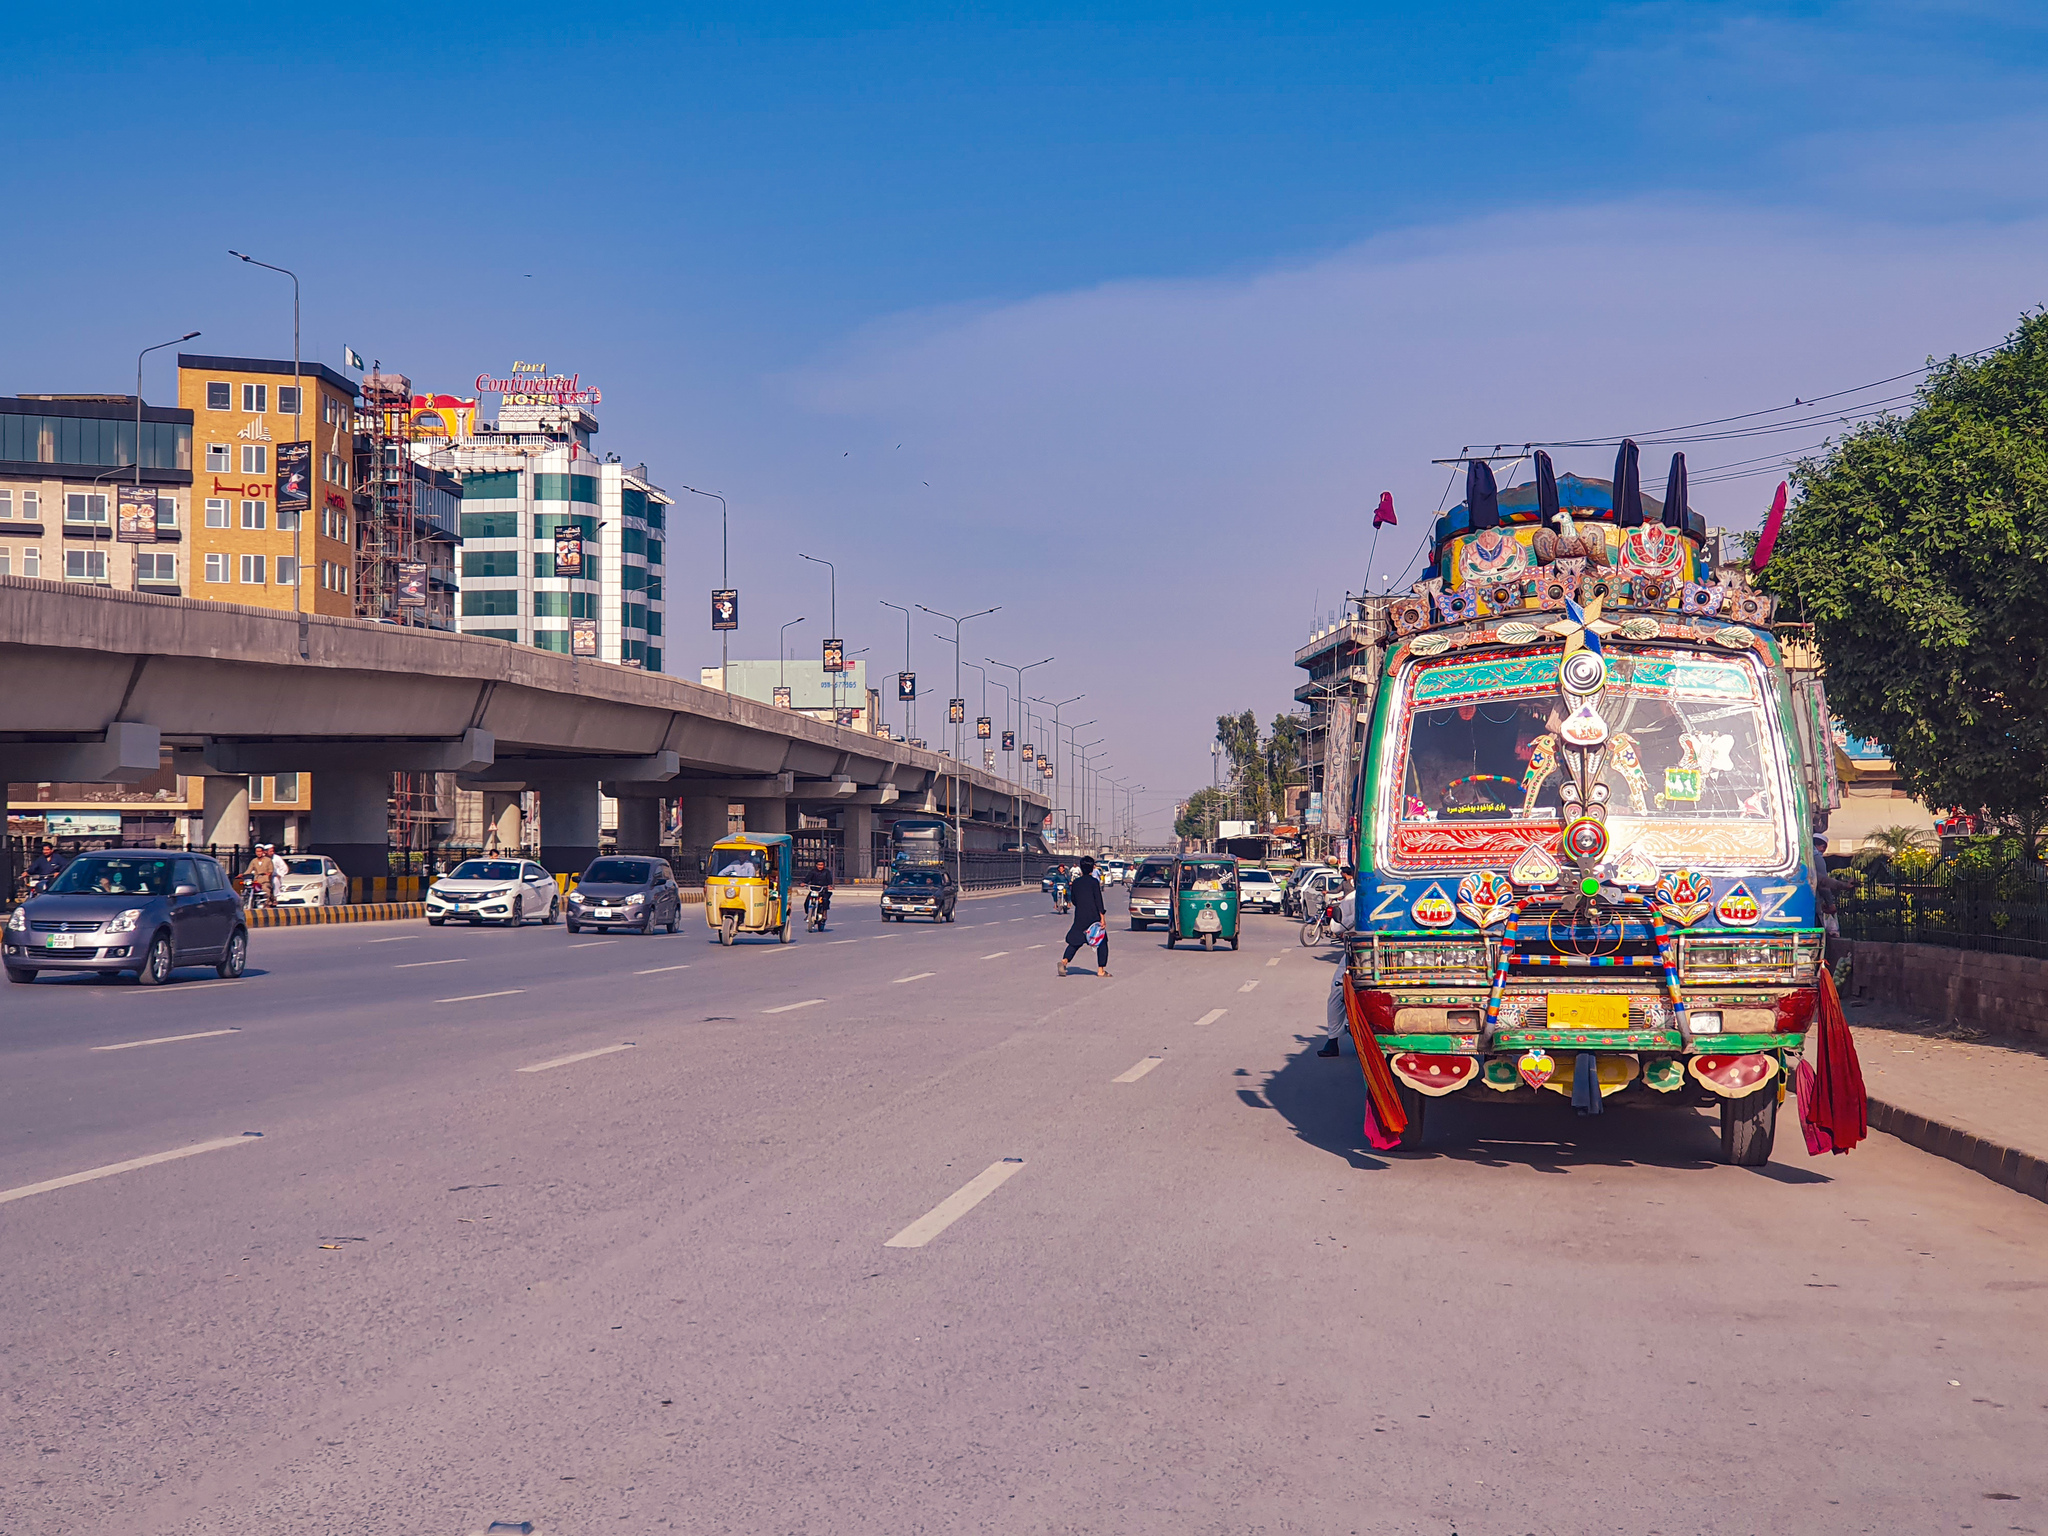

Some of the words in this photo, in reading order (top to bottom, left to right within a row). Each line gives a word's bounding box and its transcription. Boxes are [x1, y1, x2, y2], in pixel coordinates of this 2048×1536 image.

[512, 361, 546, 373] Fort
[475, 373, 579, 393] Continental
[214, 476, 277, 498] HOT
[1369, 884, 1407, 921] Z
[1761, 885, 1802, 922] Z
